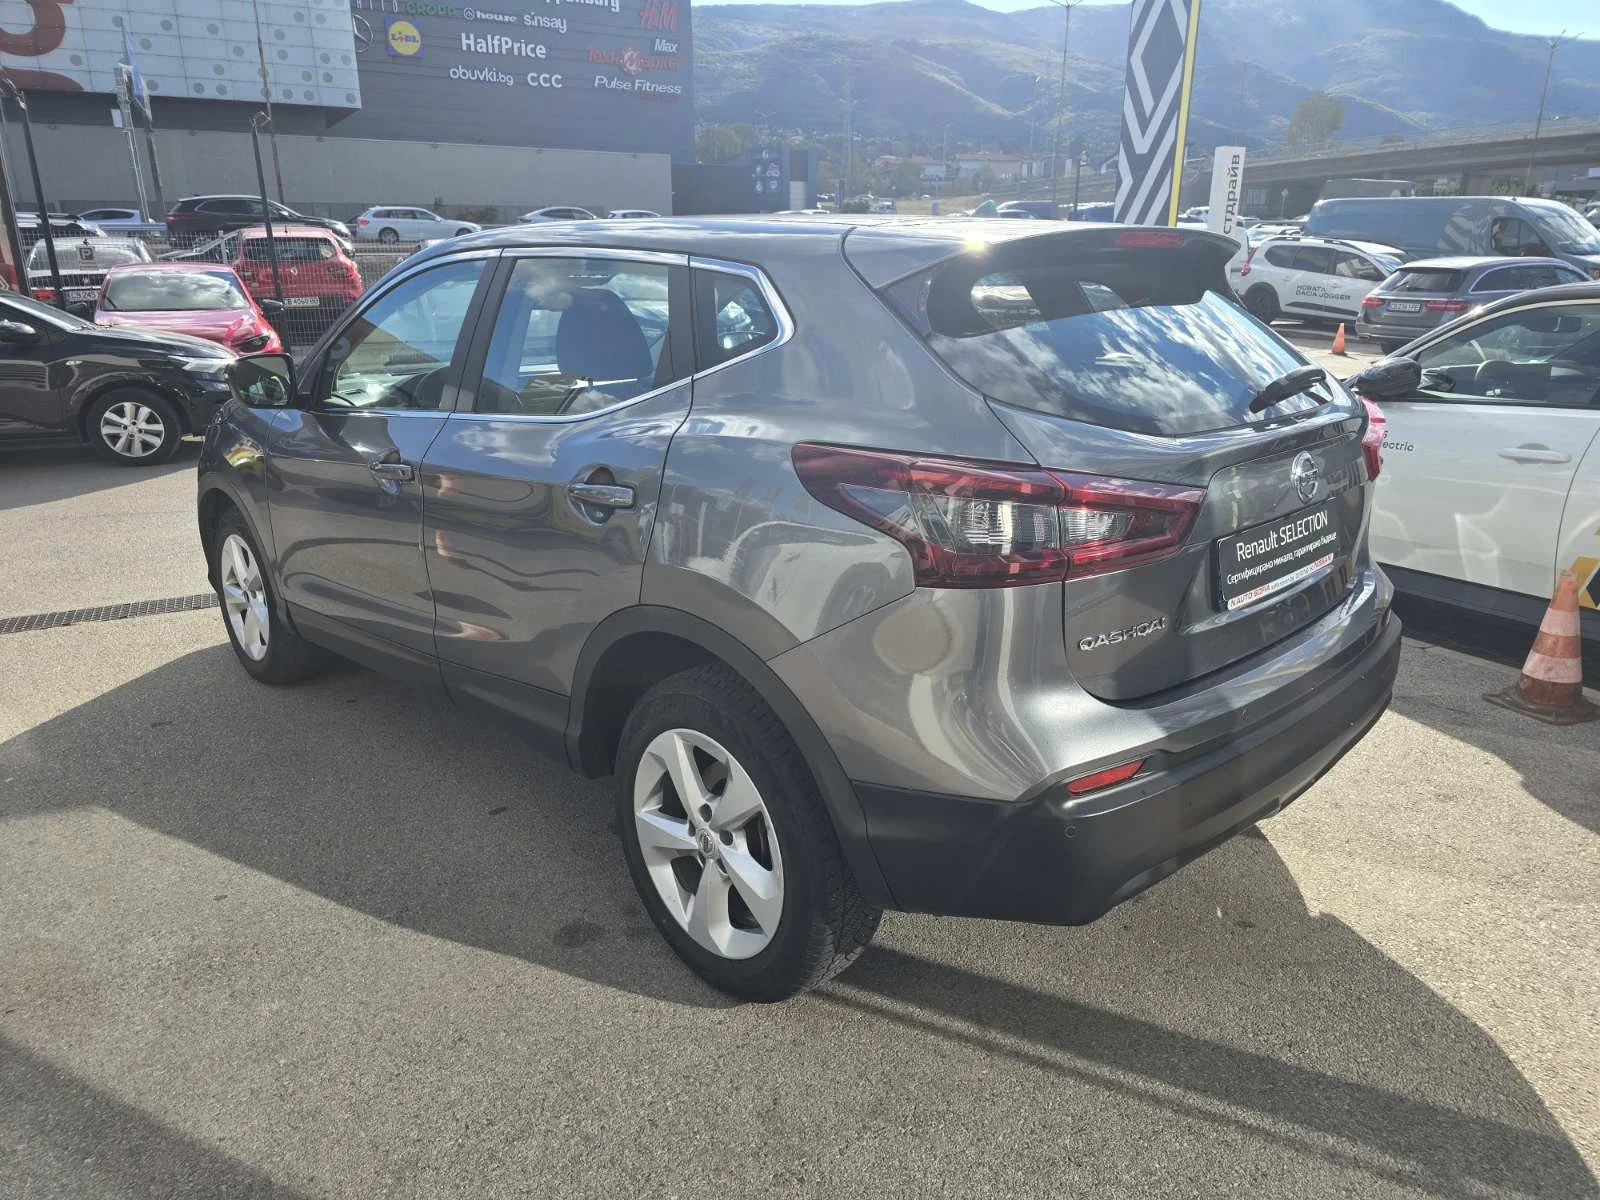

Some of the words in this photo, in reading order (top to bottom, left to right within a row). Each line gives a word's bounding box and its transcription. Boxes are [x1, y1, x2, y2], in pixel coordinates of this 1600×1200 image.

[476, 10, 518, 23] house
[523, 11, 567, 34] sinsay
[461, 32, 547, 58] HalfPrice
[654, 38, 678, 53] Max
[449, 65, 514, 86] obuvki.bg
[527, 72, 563, 88] CCC
[594, 75, 632, 90] Pulse
[634, 79, 682, 94] Fitness
[1382, 441, 1415, 452] ectric
[1236, 530, 1279, 562] Renault
[1279, 510, 1328, 546] SELECTION
[1226, 560, 1274, 585] Сертифицирано
[1079, 617, 1166, 651] QASHQAI
